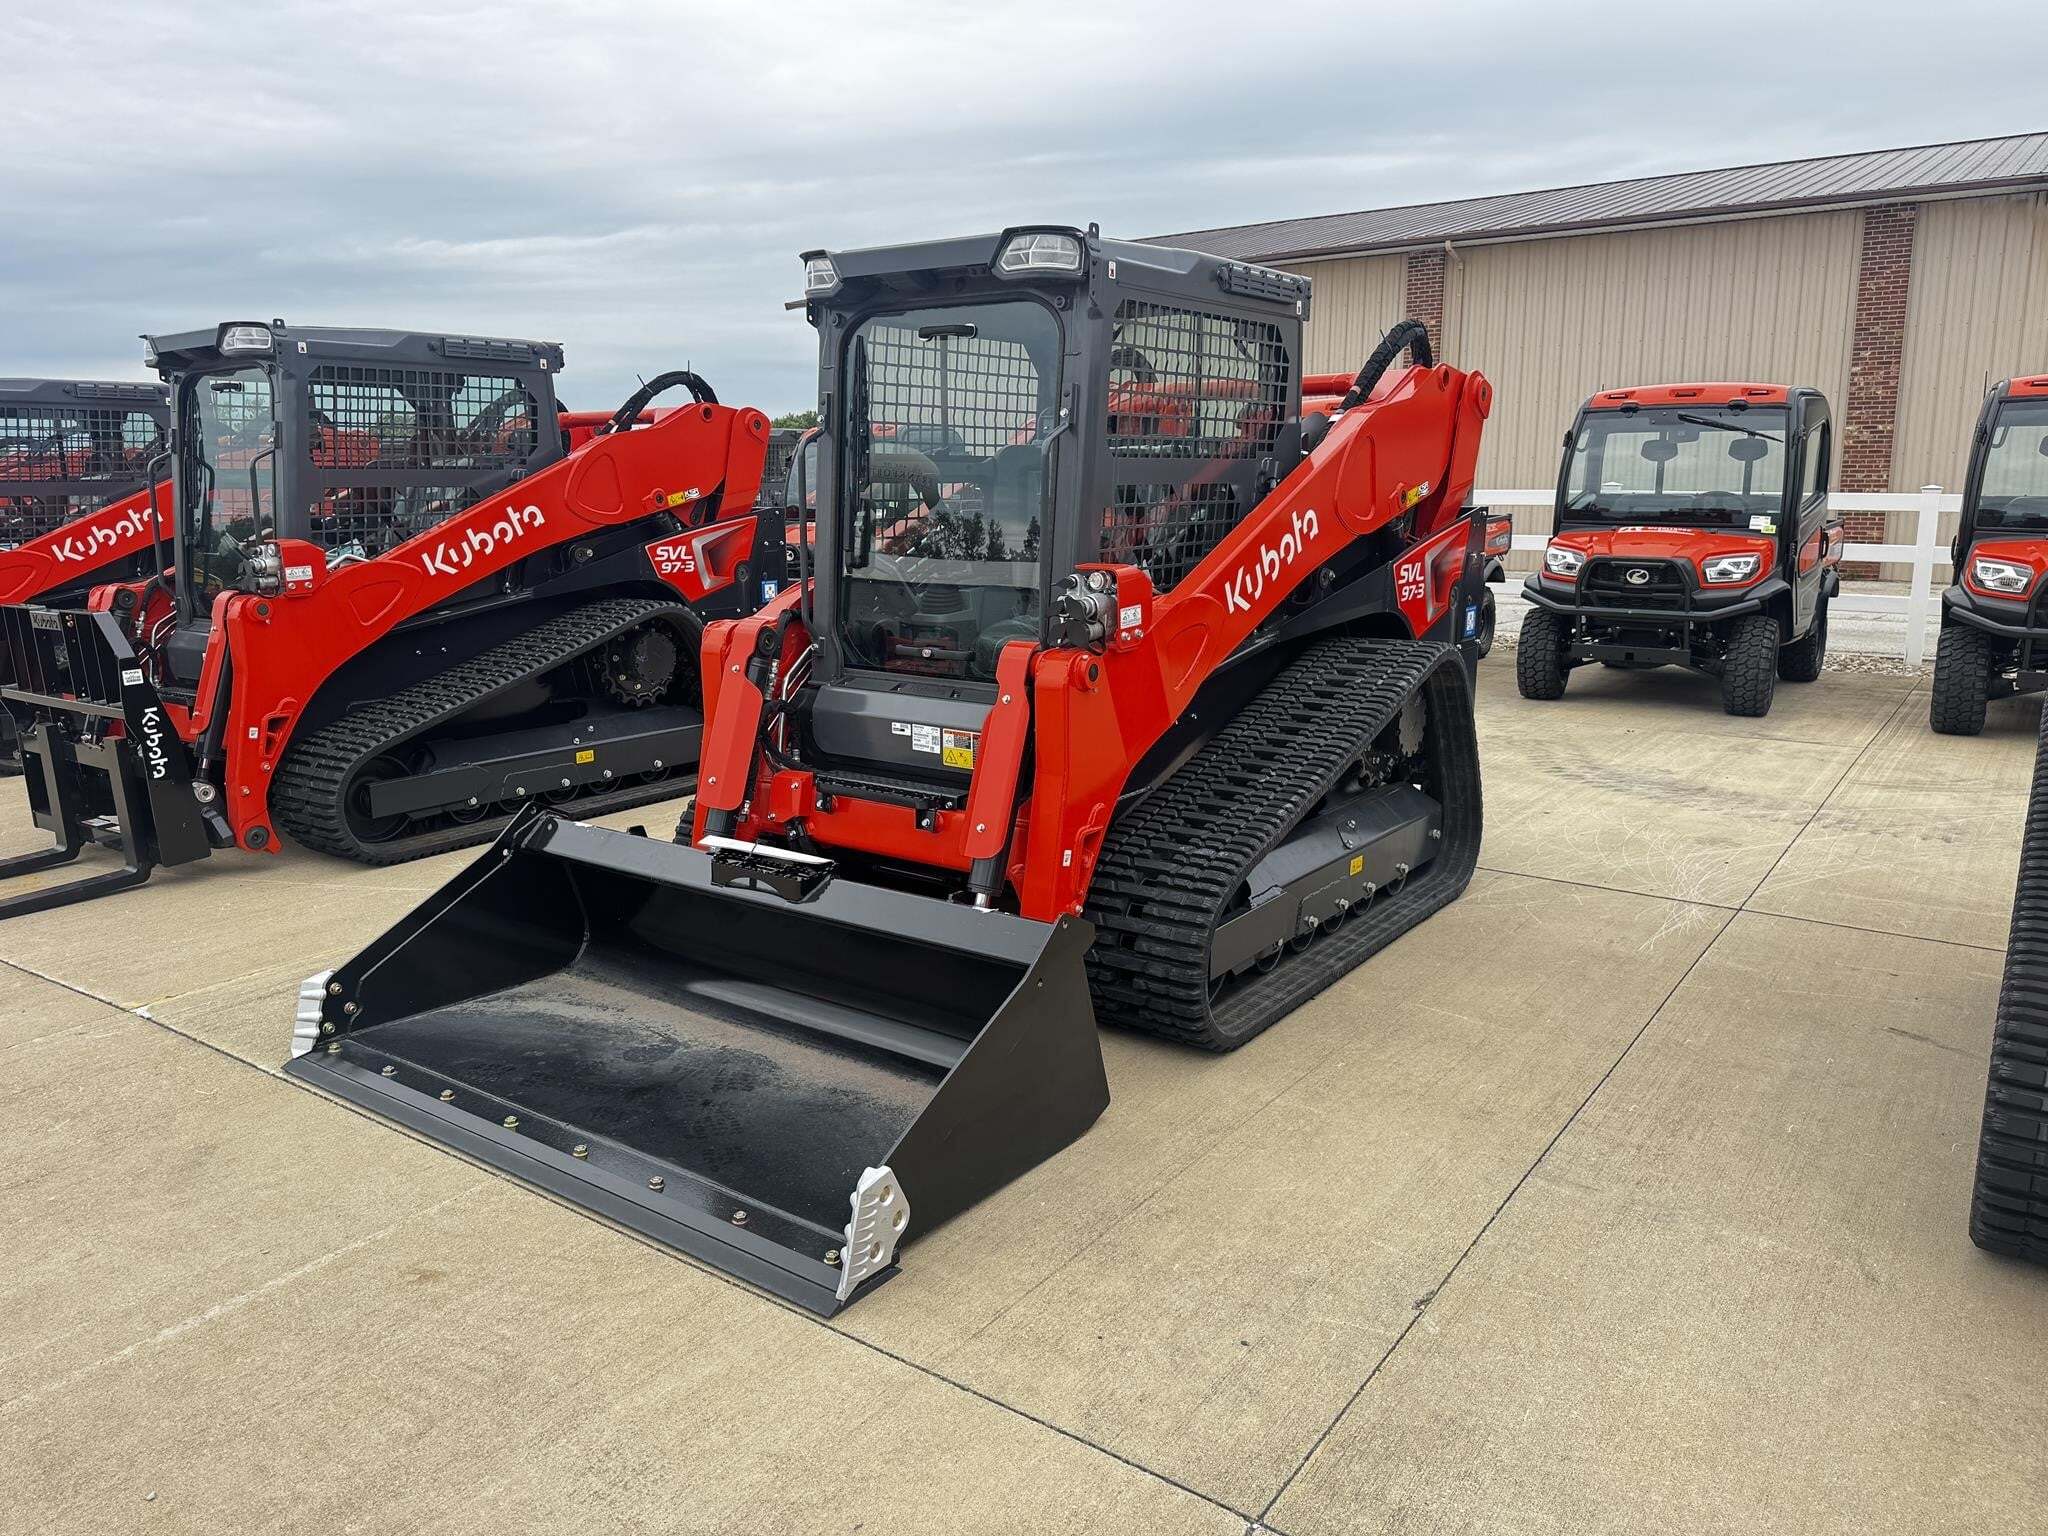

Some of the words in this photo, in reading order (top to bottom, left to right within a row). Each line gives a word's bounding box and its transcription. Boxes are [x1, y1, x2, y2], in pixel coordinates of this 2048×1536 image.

[51, 507, 163, 562] Kubota
[421, 505, 545, 576] Kubota
[655, 545, 693, 561] SVL
[661, 560, 695, 574] 97-3
[1224, 509, 1319, 614] Kubota
[1398, 562, 1424, 585] SVL
[1400, 583, 1425, 601] 97-3
[141, 706, 168, 779] Kubota
